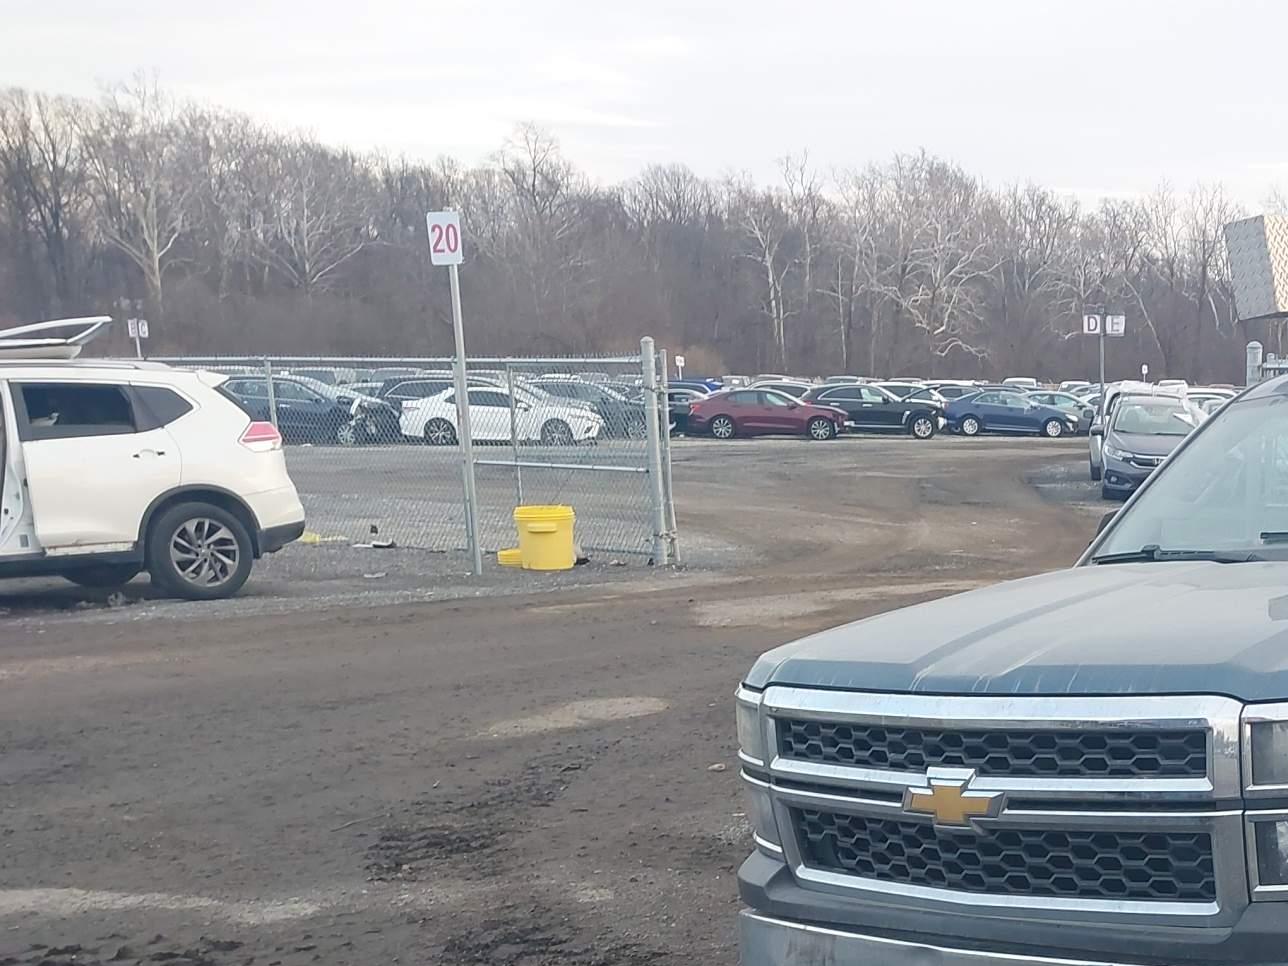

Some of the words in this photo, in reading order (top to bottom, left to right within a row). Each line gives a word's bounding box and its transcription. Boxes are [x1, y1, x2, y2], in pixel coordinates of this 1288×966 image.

[431, 223, 459, 253] 20
[1087, 316, 1098, 332] D
[1110, 316, 1120, 332] E
